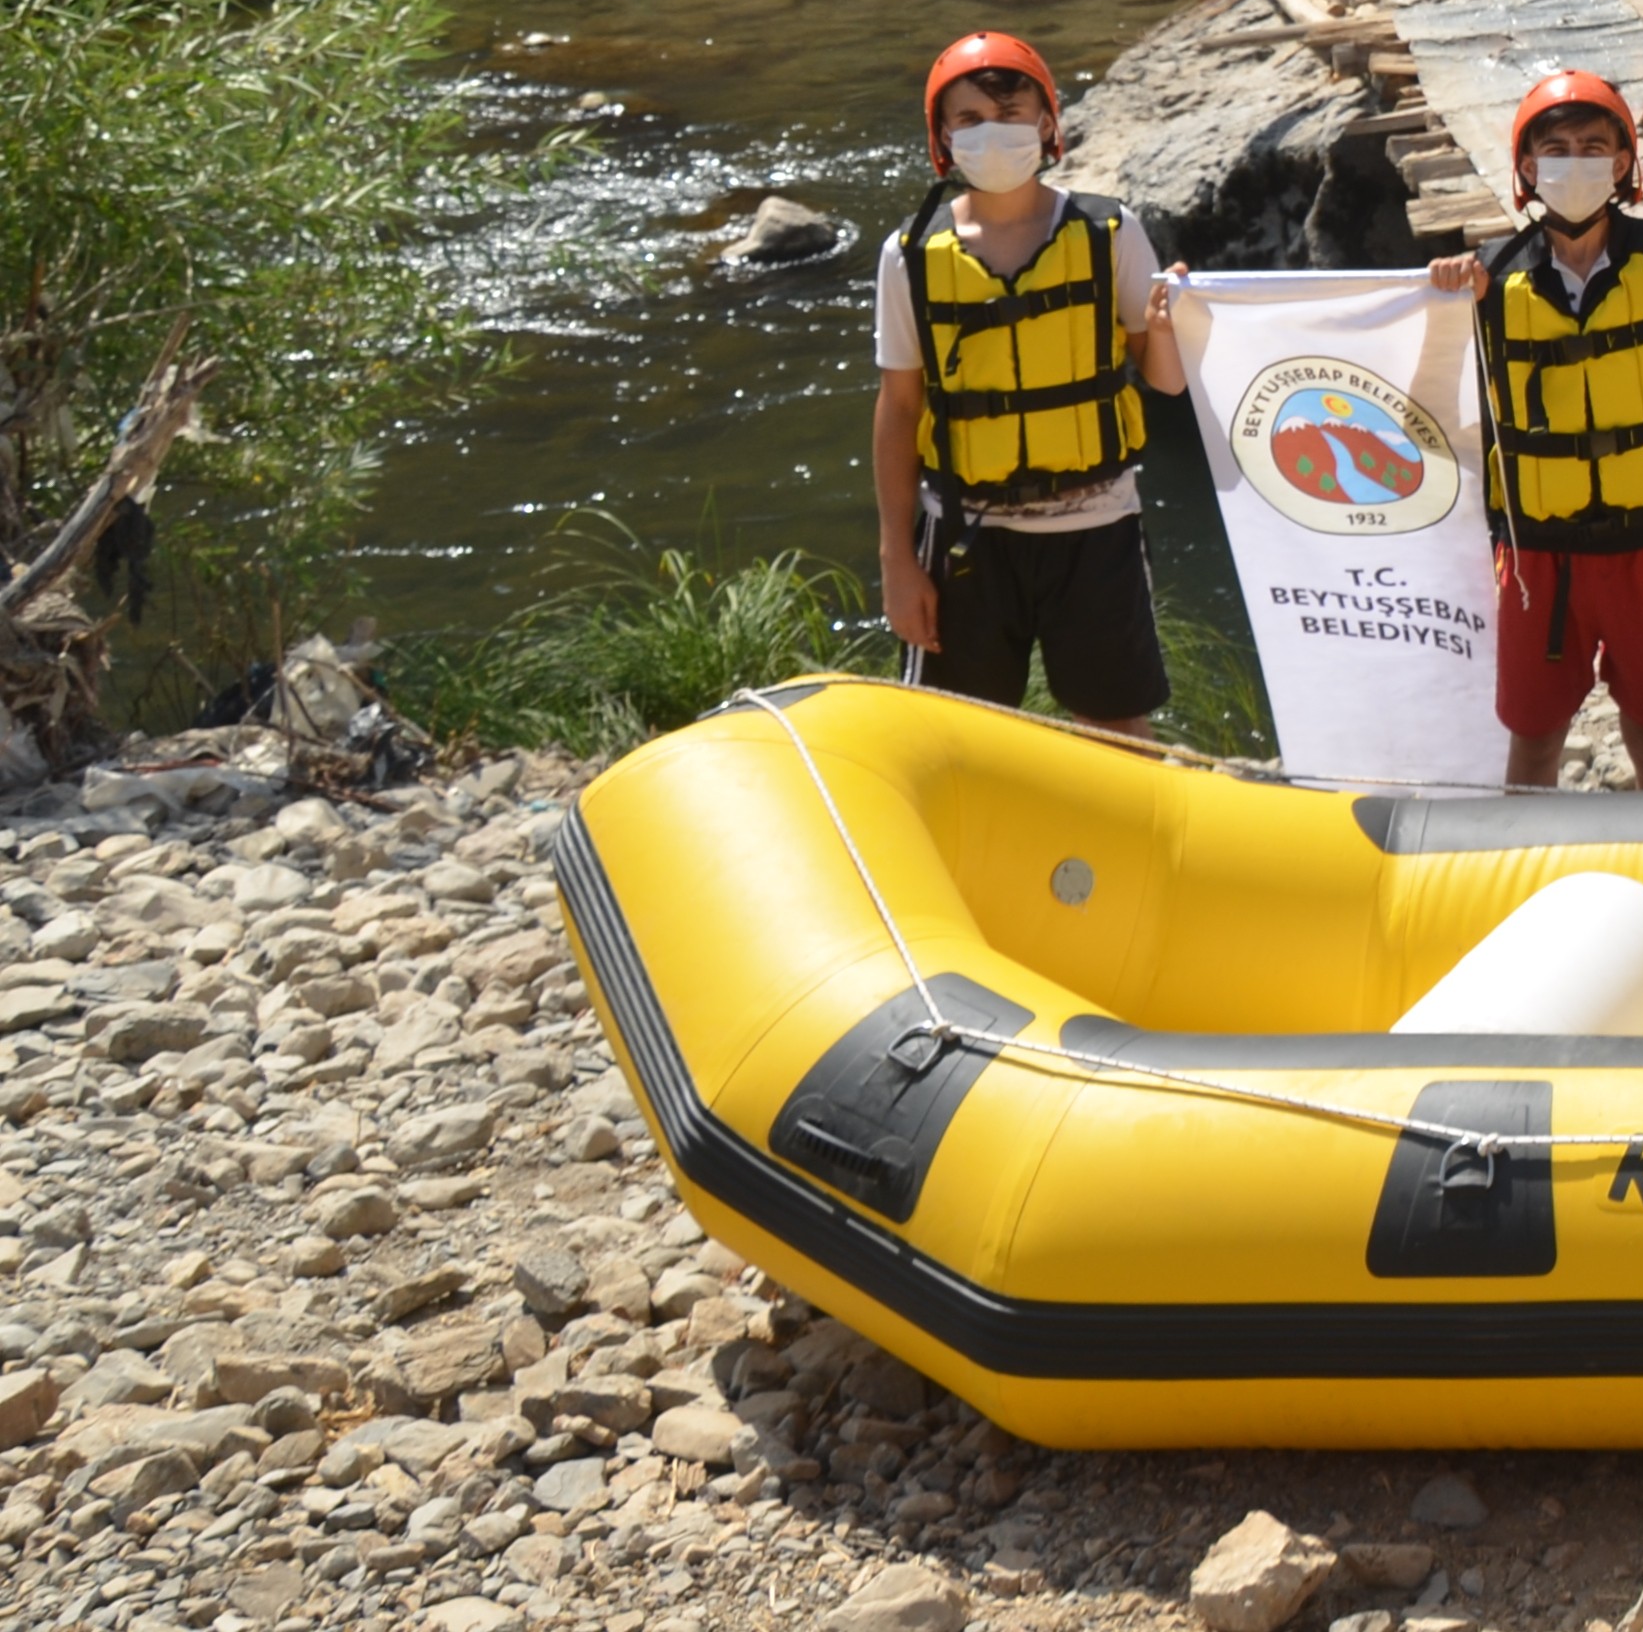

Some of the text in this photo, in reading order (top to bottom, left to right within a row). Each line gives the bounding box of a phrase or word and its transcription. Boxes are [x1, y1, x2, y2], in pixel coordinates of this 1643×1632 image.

[1346, 513, 1388, 527] 1932
[1345, 567, 1407, 587] T.C.
[1269, 586, 1486, 633] BEYTUŞŞEBAP
[1300, 616, 1472, 660] BELEDİYESİ
